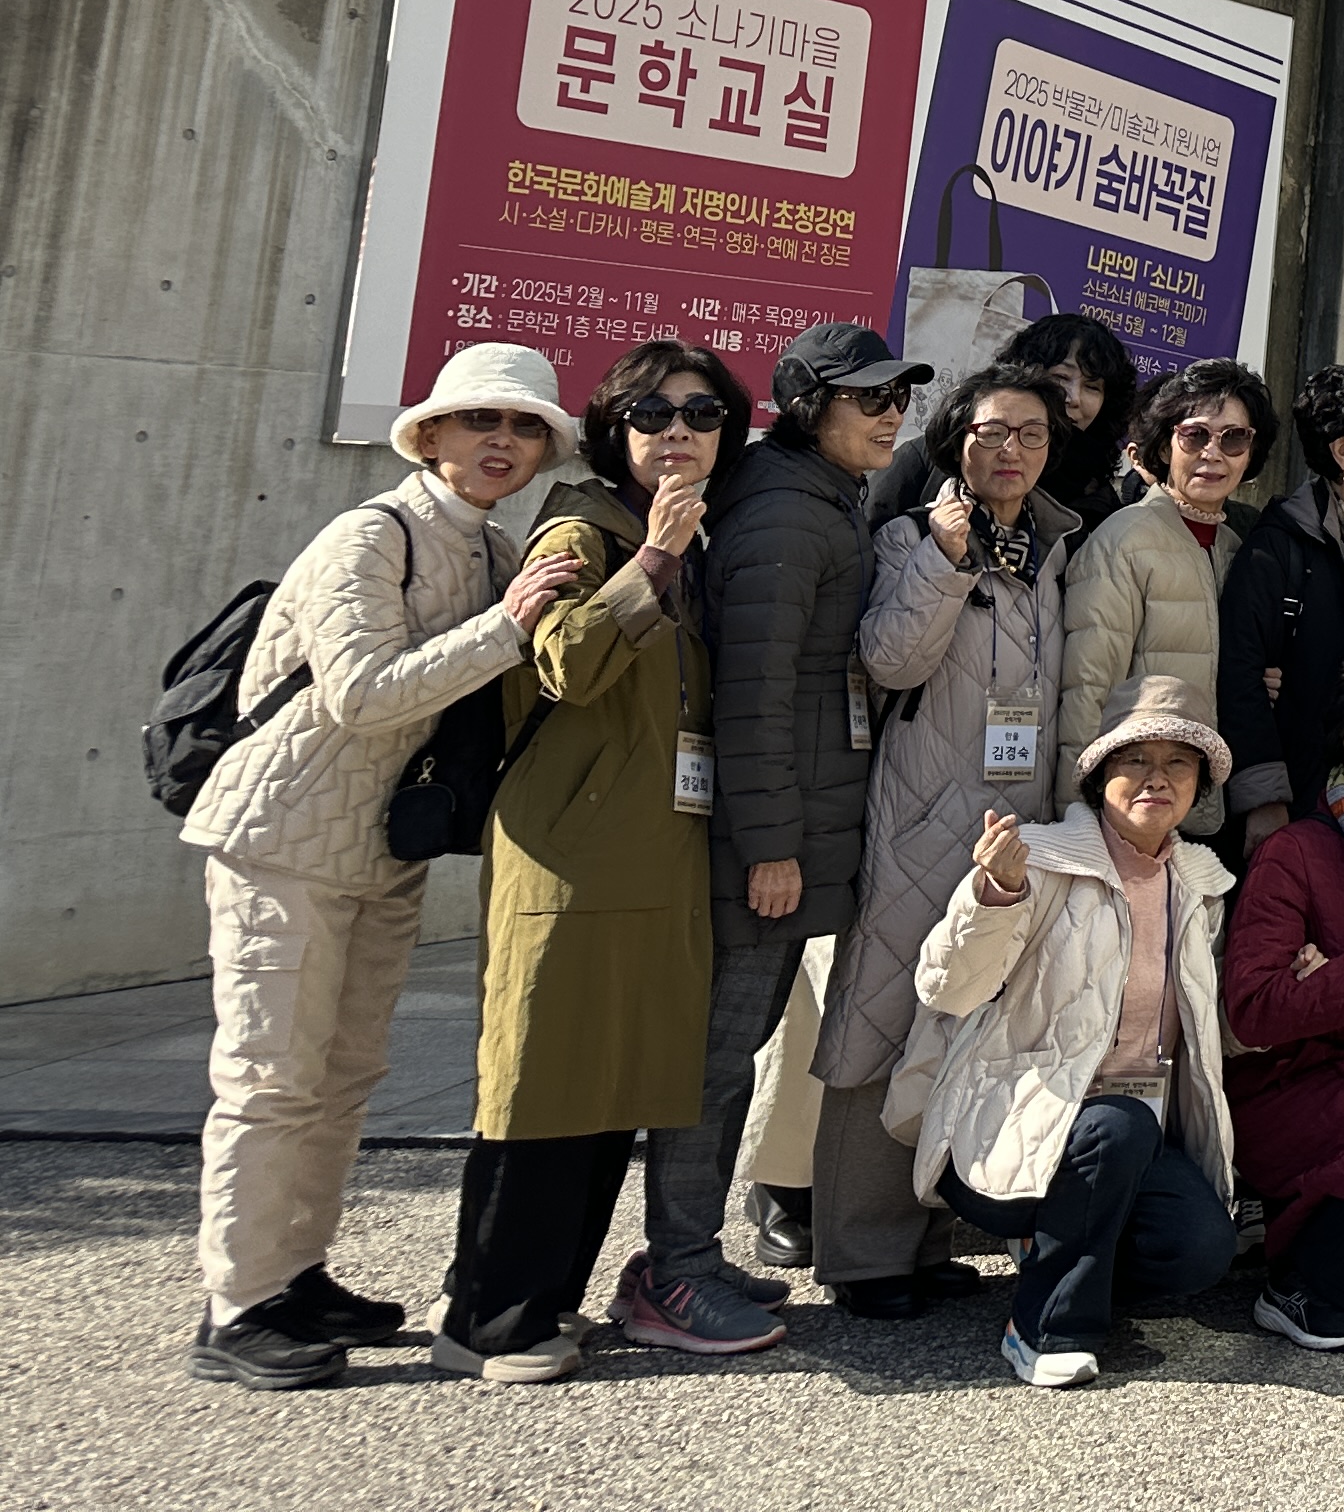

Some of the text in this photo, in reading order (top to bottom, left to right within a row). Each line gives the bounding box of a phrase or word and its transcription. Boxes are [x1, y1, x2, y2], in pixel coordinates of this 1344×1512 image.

[676, 0, 840, 69] 소나기마을
[556, 25, 835, 152] 문학교실
[1004, 69, 1050, 107] 2025
[1160, 122, 1222, 167] 지원사업
[990, 108, 1216, 240] 이야기 숨바꼭질
[507, 159, 856, 239] 한국문화예술계 저명인사 초청강연
[801, 240, 817, 263] 전
[820, 243, 851, 267] 장르
[1086, 245, 1206, 301] 나만의 「소나기」
[462, 272, 499, 299] 기간
[511, 278, 574, 303] 2025년
[577, 286, 605, 309] 2월
[623, 290, 660, 314] 11월
[688, 298, 721, 321] 시간
[732, 302, 761, 324] 매주
[765, 306, 807, 330] 목요일
[1082, 278, 1208, 326] 소년소녀 에코백 꾸미기
[456, 304, 493, 329] 장소
[507, 309, 560, 336] 문학관
[565, 315, 590, 339] 1층
[594, 316, 629, 341] 작은
[712, 329, 743, 352] 내용
[1124, 314, 1146, 338] 5월
[1161, 323, 1187, 348] 12월
[992, 746, 1029, 761] 김경숙
